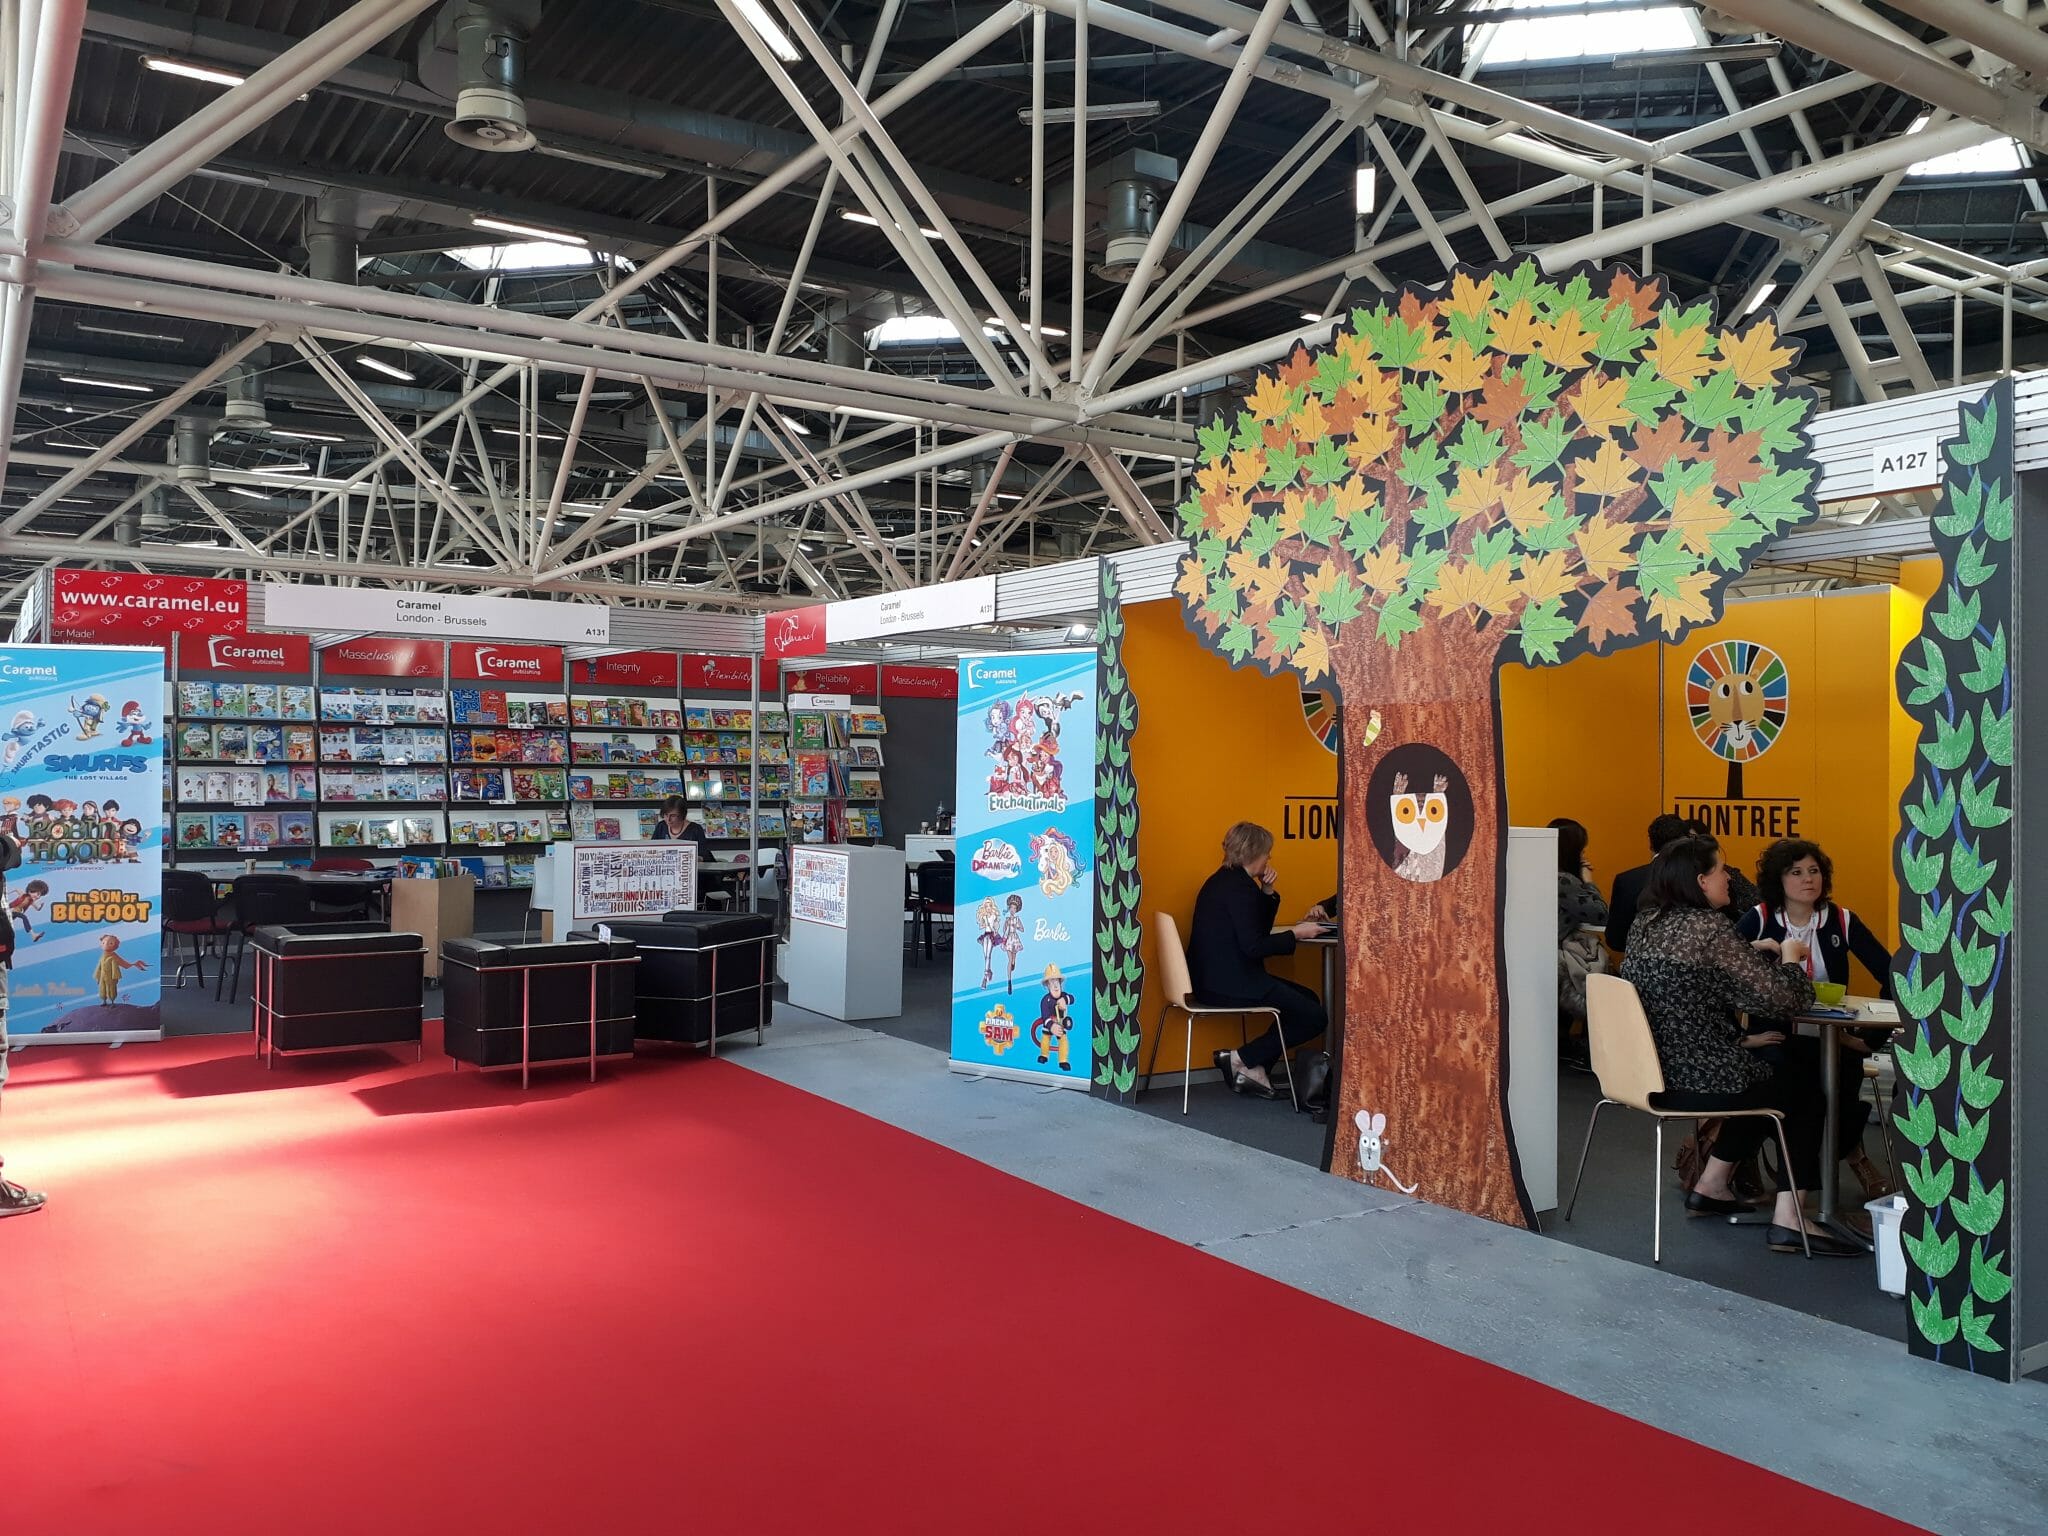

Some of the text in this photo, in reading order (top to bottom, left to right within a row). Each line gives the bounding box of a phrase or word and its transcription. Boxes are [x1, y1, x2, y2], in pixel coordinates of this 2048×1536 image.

[1881, 451, 1928, 474] A127
[61, 591, 240, 614] www.caramel.eu
[396, 599, 441, 611] Caramel
[881, 600, 902, 611] Caramel
[396, 612, 434, 624] London
[444, 616, 488, 627] Brussels
[880, 614, 897, 624] London
[900, 611, 925, 622] Brussels
[66, 628, 95, 638] Made!
[585, 628, 606, 636] A131
[222, 645, 284, 659] Caramel
[3, 664, 58, 675] Caramel
[487, 656, 541, 669] Caramel
[606, 661, 641, 674] Integrity
[709, 669, 753, 683] Flexibility
[815, 672, 851, 685] Reliability
[976, 667, 1017, 679] Caramel
[892, 675, 943, 687] Massclusivity!
[44, 754, 148, 773] SMURFS
[29, 840, 116, 861] HOOD
[982, 840, 1014, 860] Barbie
[611, 854, 622, 877] NEW
[628, 866, 675, 877] Bestsellers
[582, 866, 591, 896] CREATION
[678, 850, 689, 905] Educational
[67, 889, 137, 904] THE SON OF
[623, 890, 664, 901] INNOVATIVE
[52, 902, 150, 921] BIGFOOT
[610, 901, 645, 913] BOOKS
[1034, 918, 1071, 942] Barbie
[985, 1025, 1013, 1041] SAM
